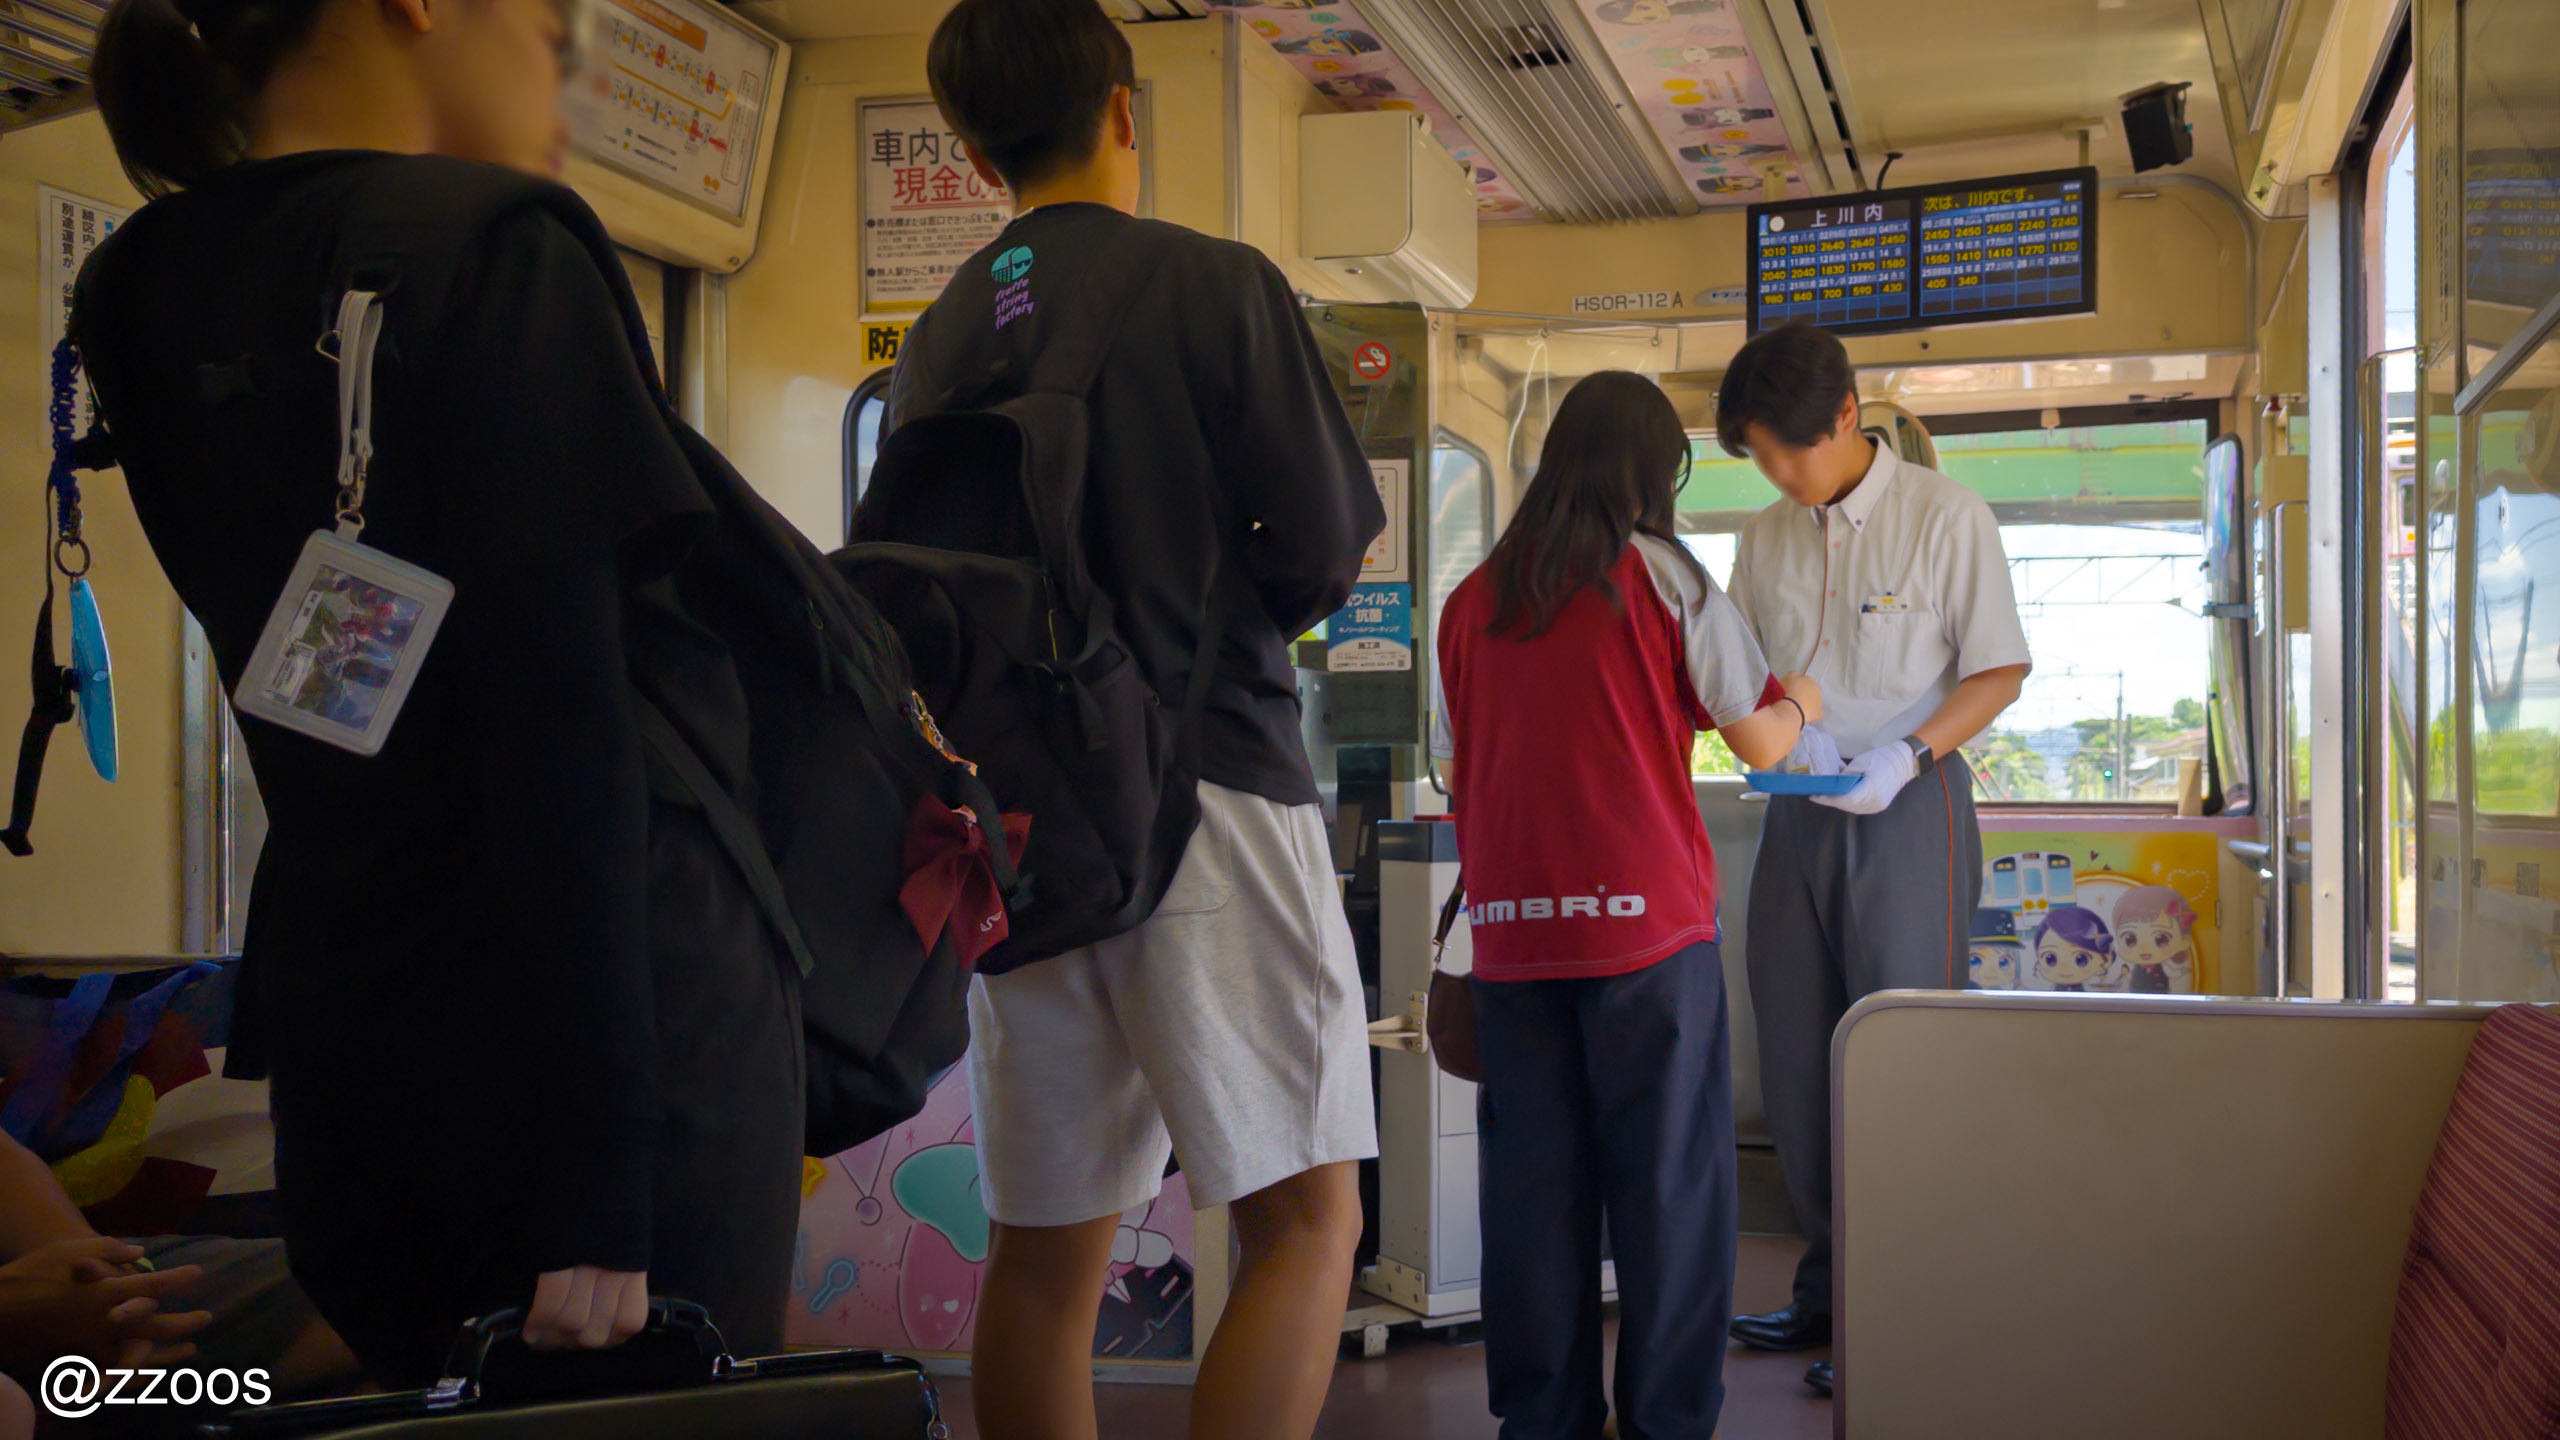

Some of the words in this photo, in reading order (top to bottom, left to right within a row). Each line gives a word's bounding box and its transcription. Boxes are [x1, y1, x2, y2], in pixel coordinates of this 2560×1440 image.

[892, 163, 1009, 205] 現金の
[1924, 187, 2035, 212] 次は、川内です。
[1924, 229, 1951, 241] 2450
[1955, 226, 1982, 238] 2450
[1986, 223, 2013, 235] 2450
[2019, 220, 2046, 231] 2240
[2051, 216, 2078, 228] 2240
[1763, 246, 1787, 258] 3010
[1791, 243, 1816, 255] 2810
[1821, 240, 1846, 252] 2640
[1850, 237, 1876, 249] 2640
[1880, 234, 1906, 246] 2450
[1925, 253, 1950, 265] 1550
[1956, 251, 1982, 262] 1410
[1987, 247, 2013, 258] 1410
[2019, 244, 2045, 255] 1270
[2052, 241, 2078, 252] 1120
[1762, 270, 1787, 281] 2040
[1791, 267, 1816, 279] 2040
[1821, 264, 1845, 275] 1830
[1851, 261, 1876, 272] 1790
[1881, 258, 1906, 269] 1580
[1764, 294, 1784, 304] 980
[1793, 291, 1813, 302] 840
[1823, 288, 1843, 299] 700
[1852, 285, 1872, 296] 590
[1883, 282, 1903, 293] 430
[1926, 278, 1947, 289] 400
[1958, 275, 1978, 287] 340
